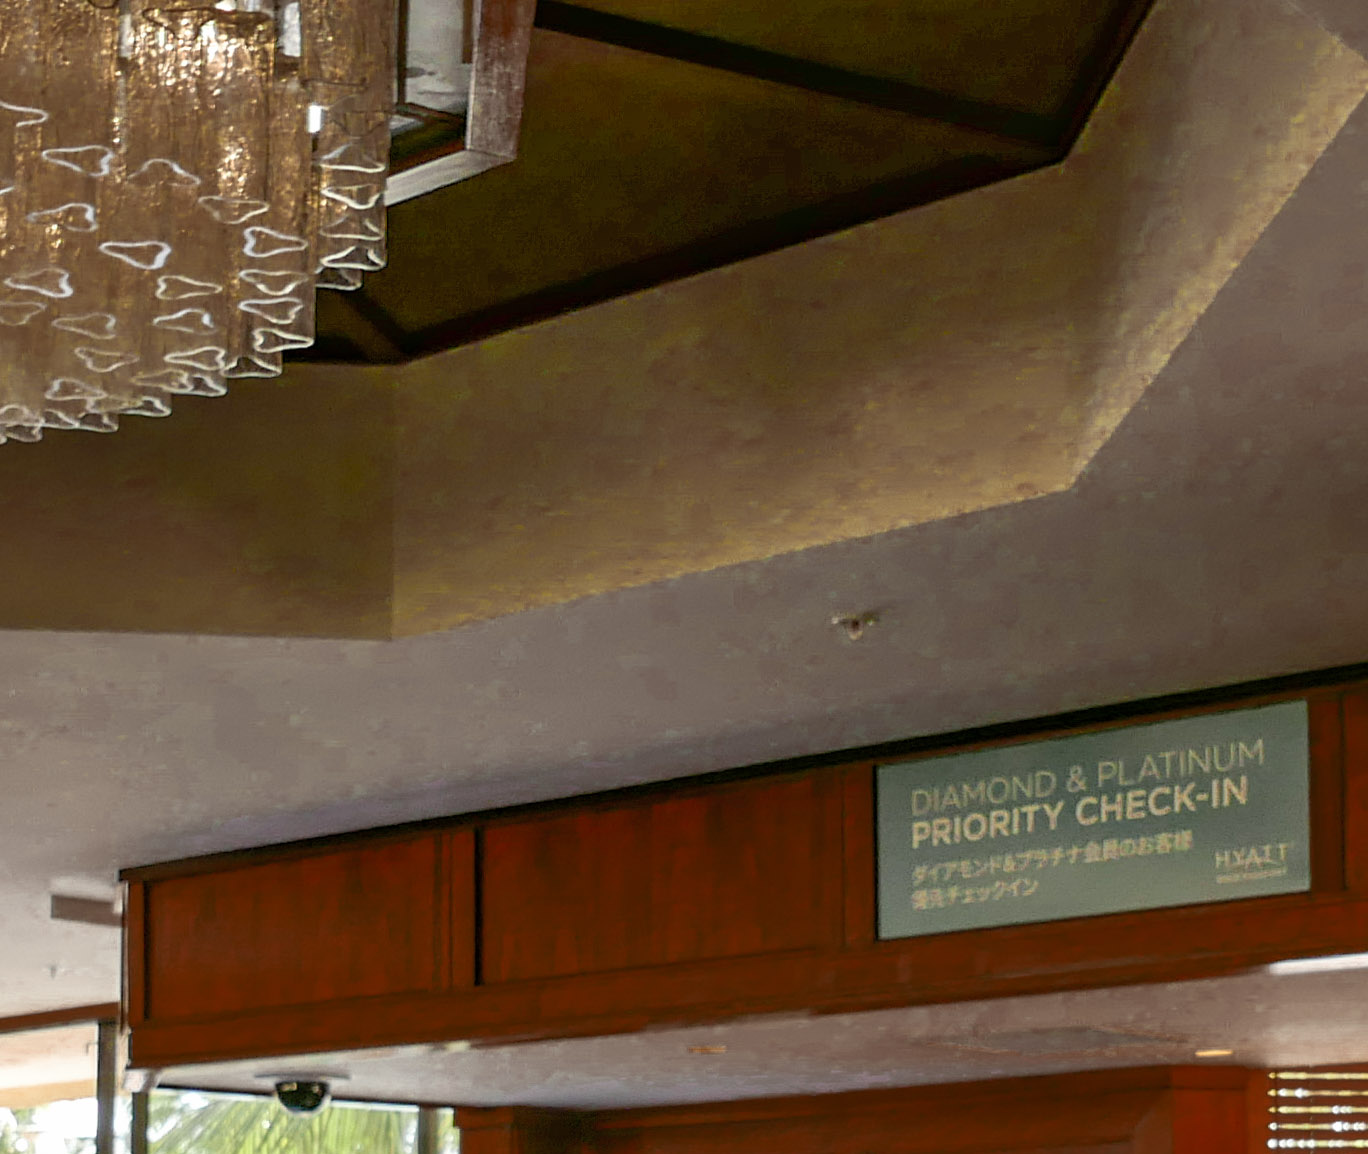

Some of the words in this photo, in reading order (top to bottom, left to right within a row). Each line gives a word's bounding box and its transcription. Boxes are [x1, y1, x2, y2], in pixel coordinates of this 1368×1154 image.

[911, 771, 1056, 817] DIAMOND
[1067, 765, 1086, 793] &
[1098, 738, 1265, 786] PLATINUM
[911, 802, 1064, 849] PRIORITY
[1075, 775, 1249, 826] CHECK-IN
[1215, 843, 1289, 869] HYATT
